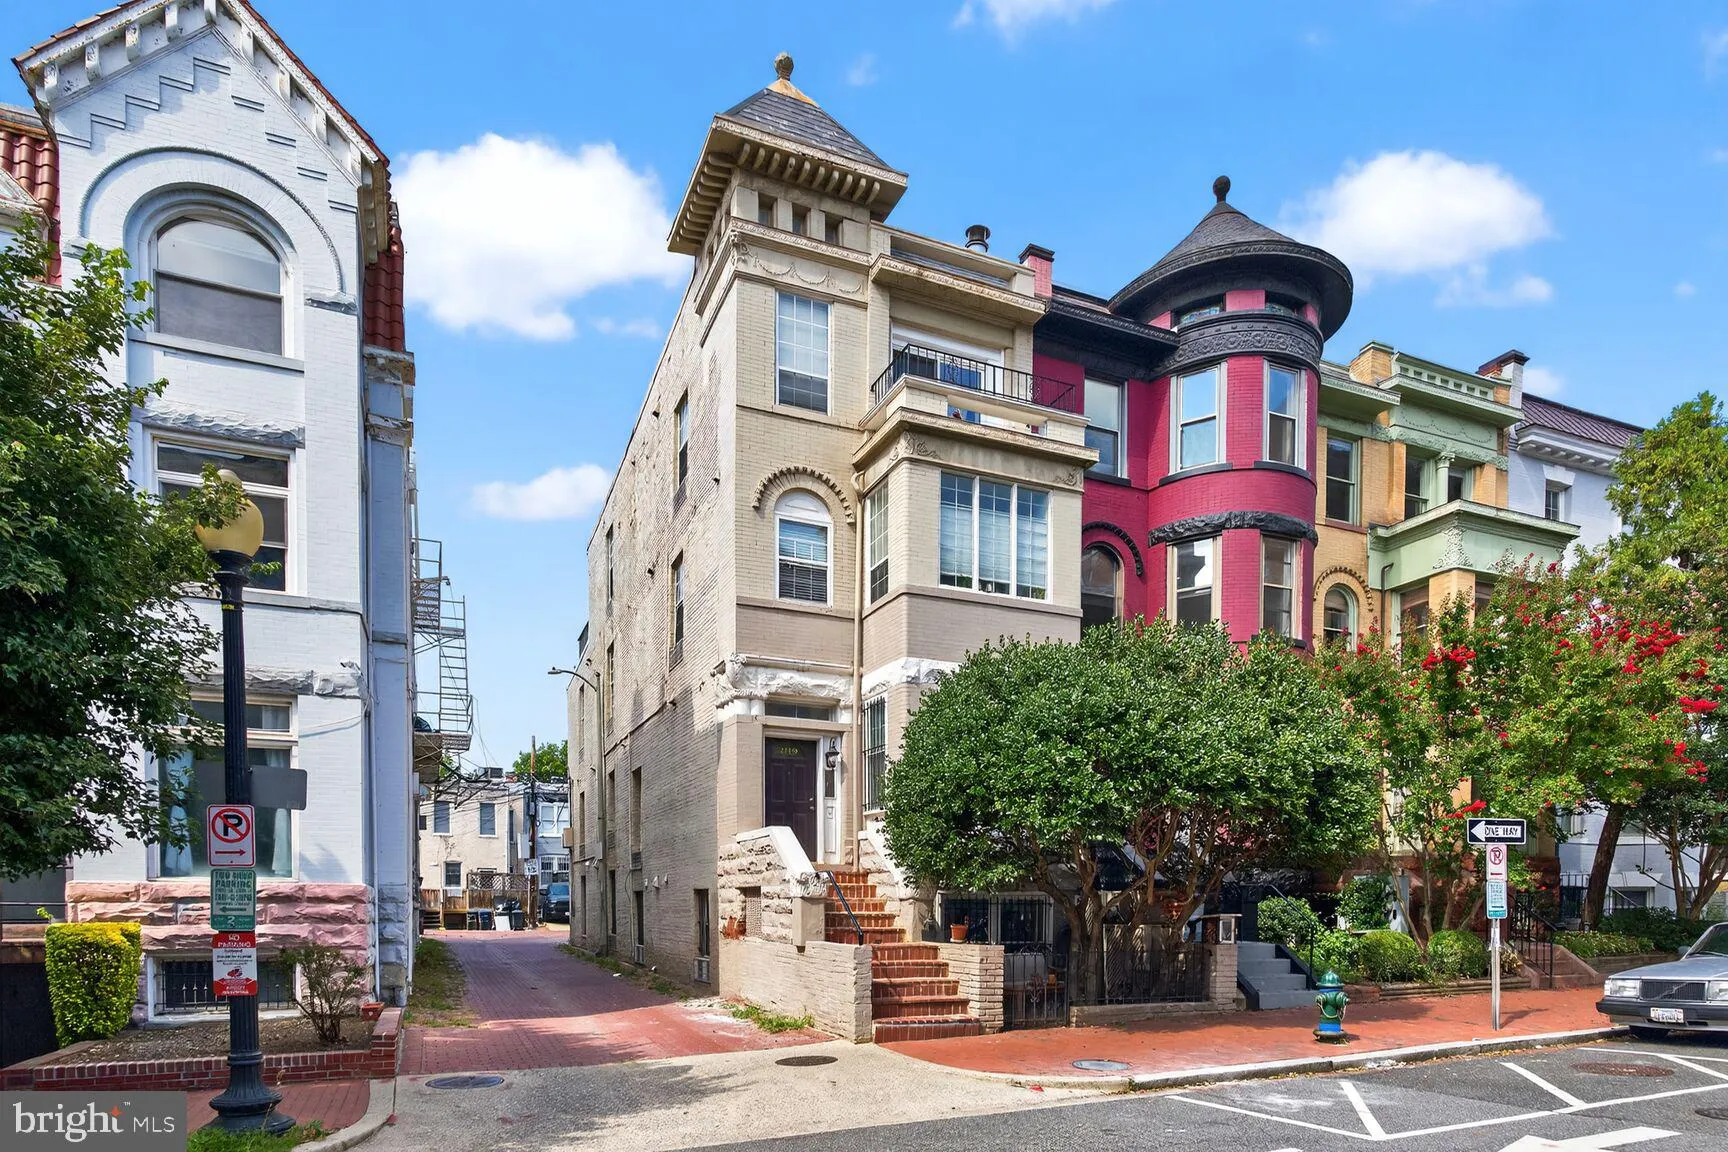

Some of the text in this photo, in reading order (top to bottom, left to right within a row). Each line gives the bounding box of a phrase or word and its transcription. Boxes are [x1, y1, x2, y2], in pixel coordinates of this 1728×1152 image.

[1485, 826, 1518, 836] ONE WAY
[215, 880, 252, 889] PARKING
